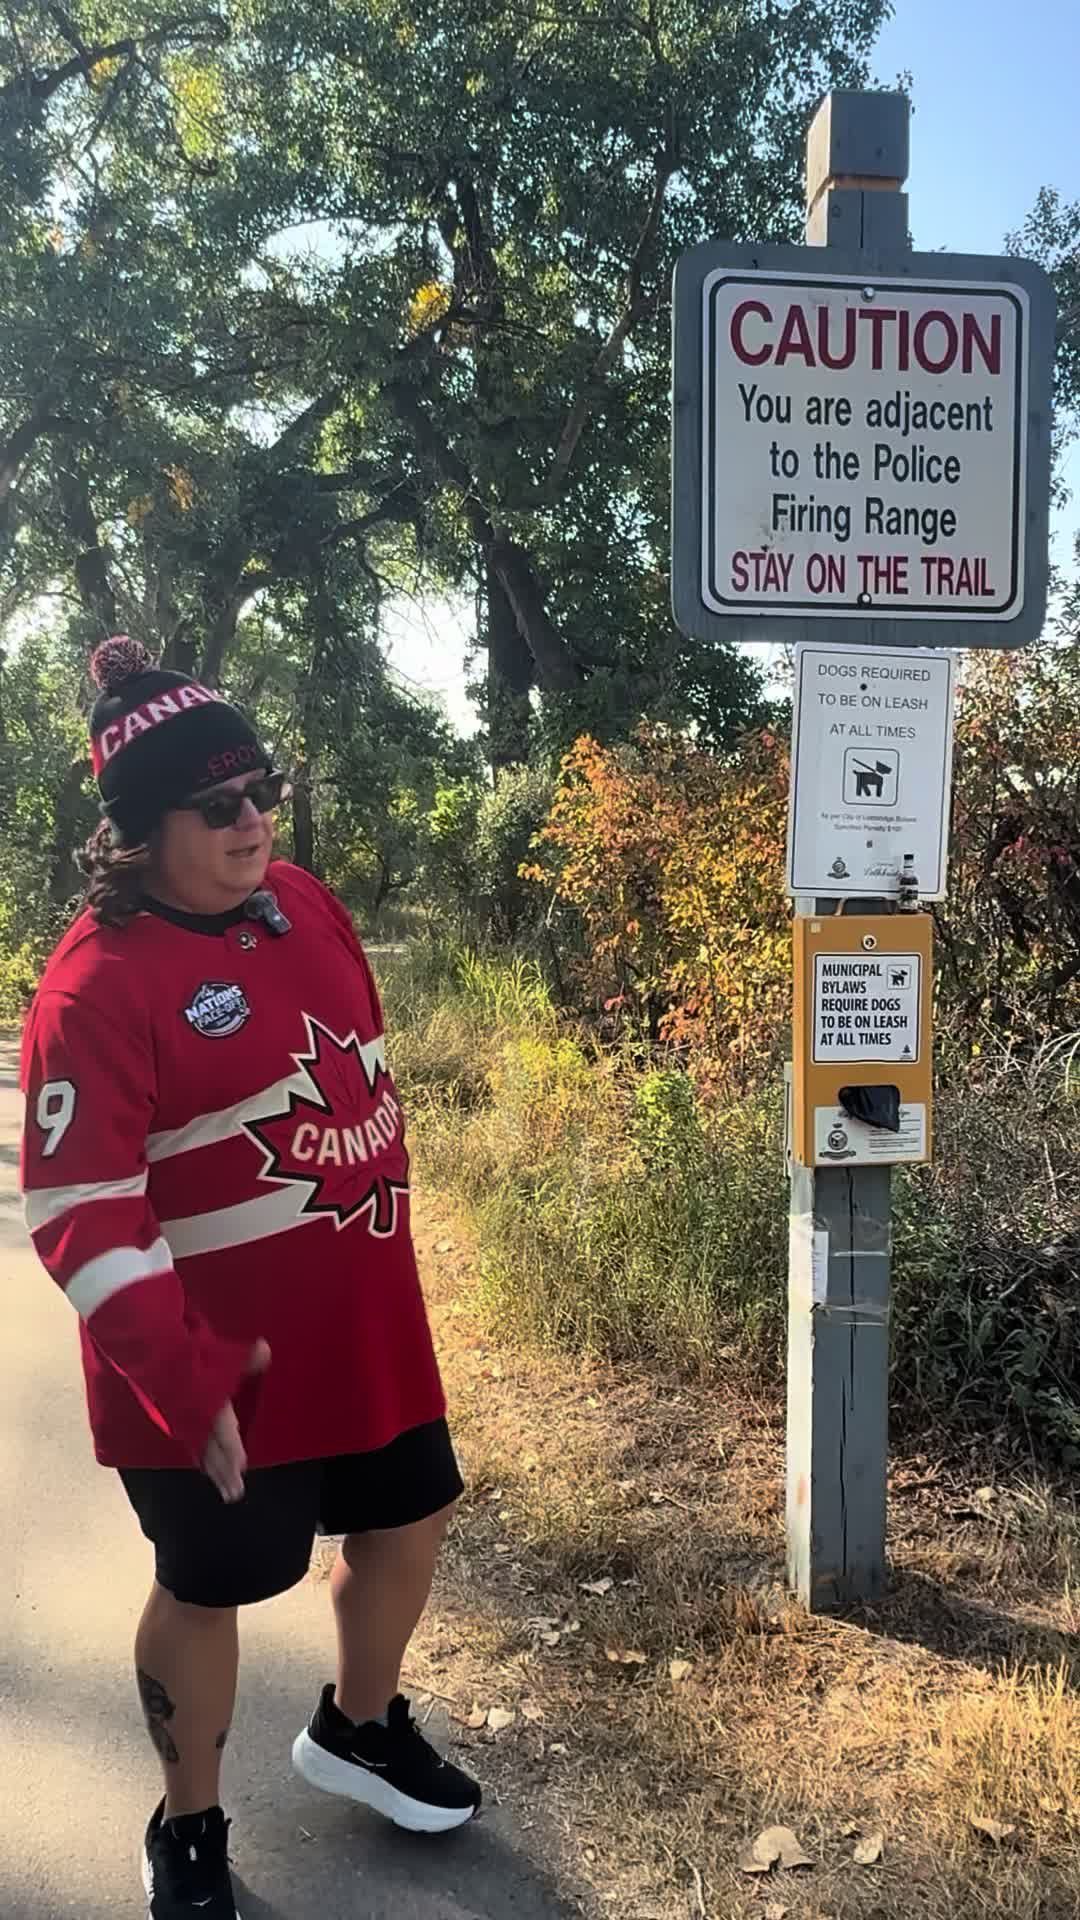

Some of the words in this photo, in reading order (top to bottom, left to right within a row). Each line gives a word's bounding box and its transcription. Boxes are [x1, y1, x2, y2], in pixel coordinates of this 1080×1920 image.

[730, 300, 1001, 375] CAUTION
[738, 383, 791, 424] You
[806, 396, 851, 426] are
[866, 391, 993, 437] adjacent
[770, 441, 799, 478] to
[813, 442, 860, 481] the
[874, 444, 961, 484] Police
[772, 494, 850, 542] Firing
[865, 497, 956, 545] Range
[731, 551, 794, 593] STAY
[806, 553, 845, 594] ON
[857, 556, 909, 596] THE
[921, 557, 995, 597] TRAIL
[818, 664, 857, 678] DOGS
[861, 666, 931, 681] REQUIRED
[818, 692, 836, 705] TO
[840, 694, 857, 706] BE
[861, 695, 881, 708] ON
[885, 697, 928, 710] LEASH
[101, 685, 222, 760] CANA
[830, 723, 846, 736] AT
[849, 725, 872, 737] ALL
[877, 725, 916, 739] TIMES
[822, 964, 882, 977] MUNICIPAL
[822, 981, 867, 994] BYLAWS
[185, 985, 243, 1023] NATIONS
[821, 998, 869, 1013] REQUIRE
[871, 998, 901, 1012] DOGS
[821, 1015, 835, 1029] TO
[838, 1015, 852, 1029] BE
[854, 1015, 871, 1029] ON
[874, 1015, 908, 1029] LEASH
[820, 1032, 834, 1046] AT
[836, 1032, 856, 1046] ALL
[858, 1032, 892, 1046] TIMES
[36, 1080, 76, 1158] 9
[291, 1091, 399, 1166] CANADA
